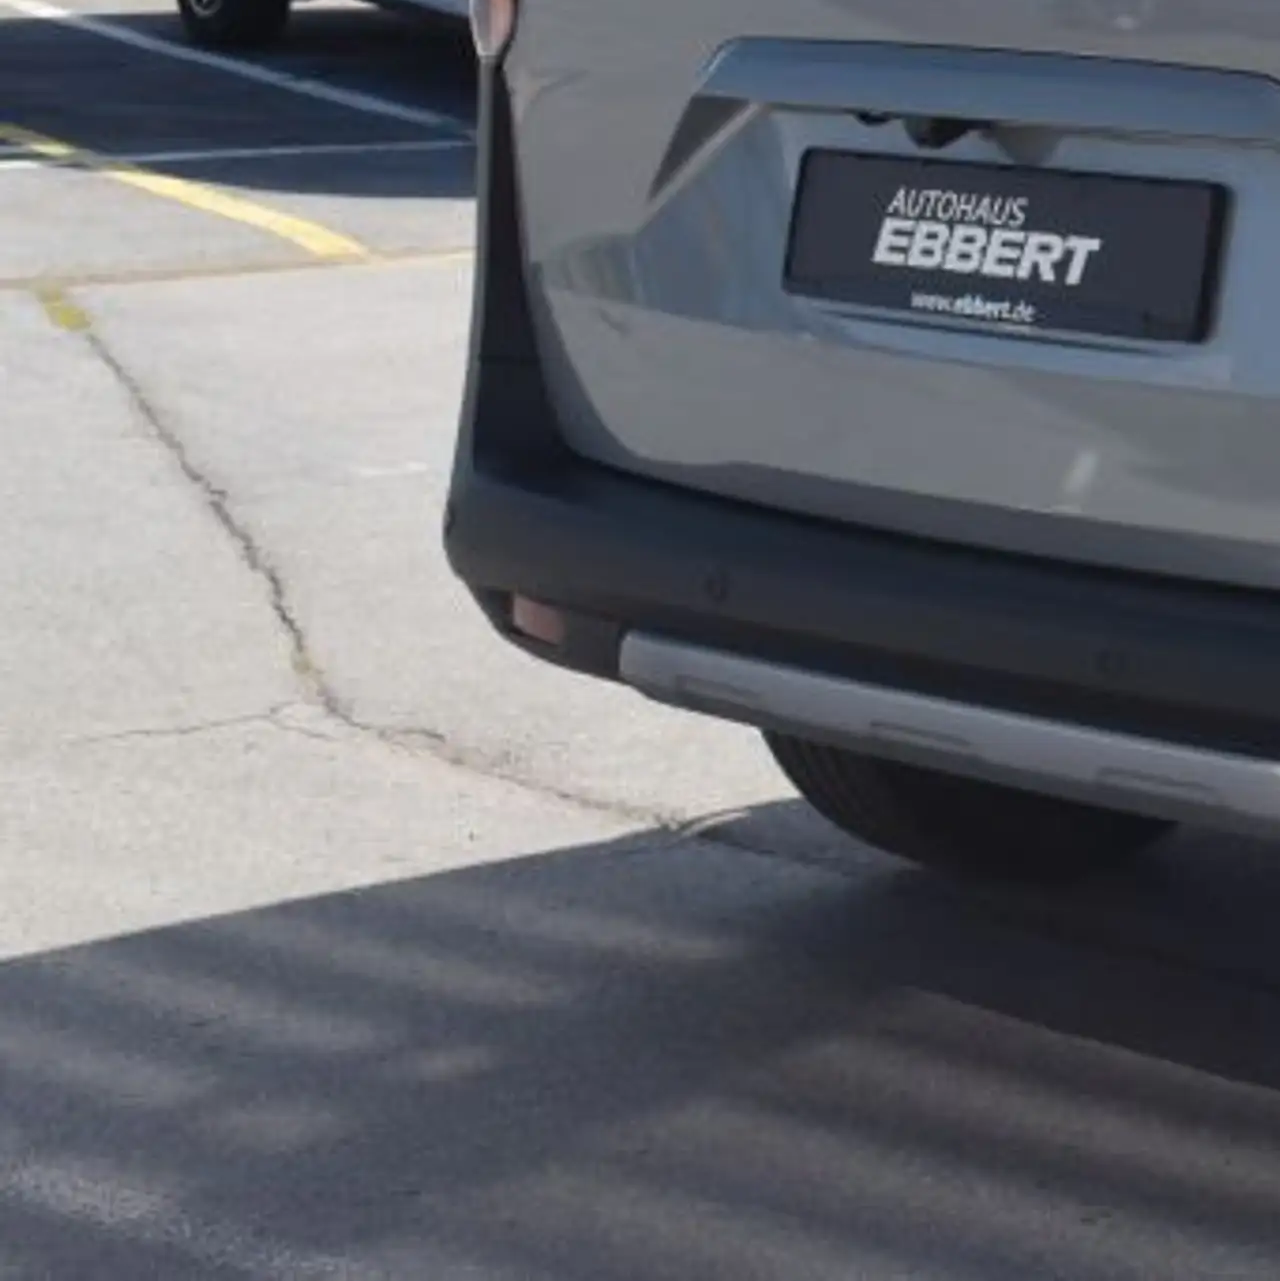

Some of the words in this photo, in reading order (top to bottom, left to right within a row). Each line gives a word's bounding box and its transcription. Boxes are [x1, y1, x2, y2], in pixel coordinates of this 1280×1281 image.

[886, 187, 1029, 228] AUTOHAUS
[871, 217, 1102, 287] EBBERT
[911, 291, 1037, 323] www.ebbert.de
